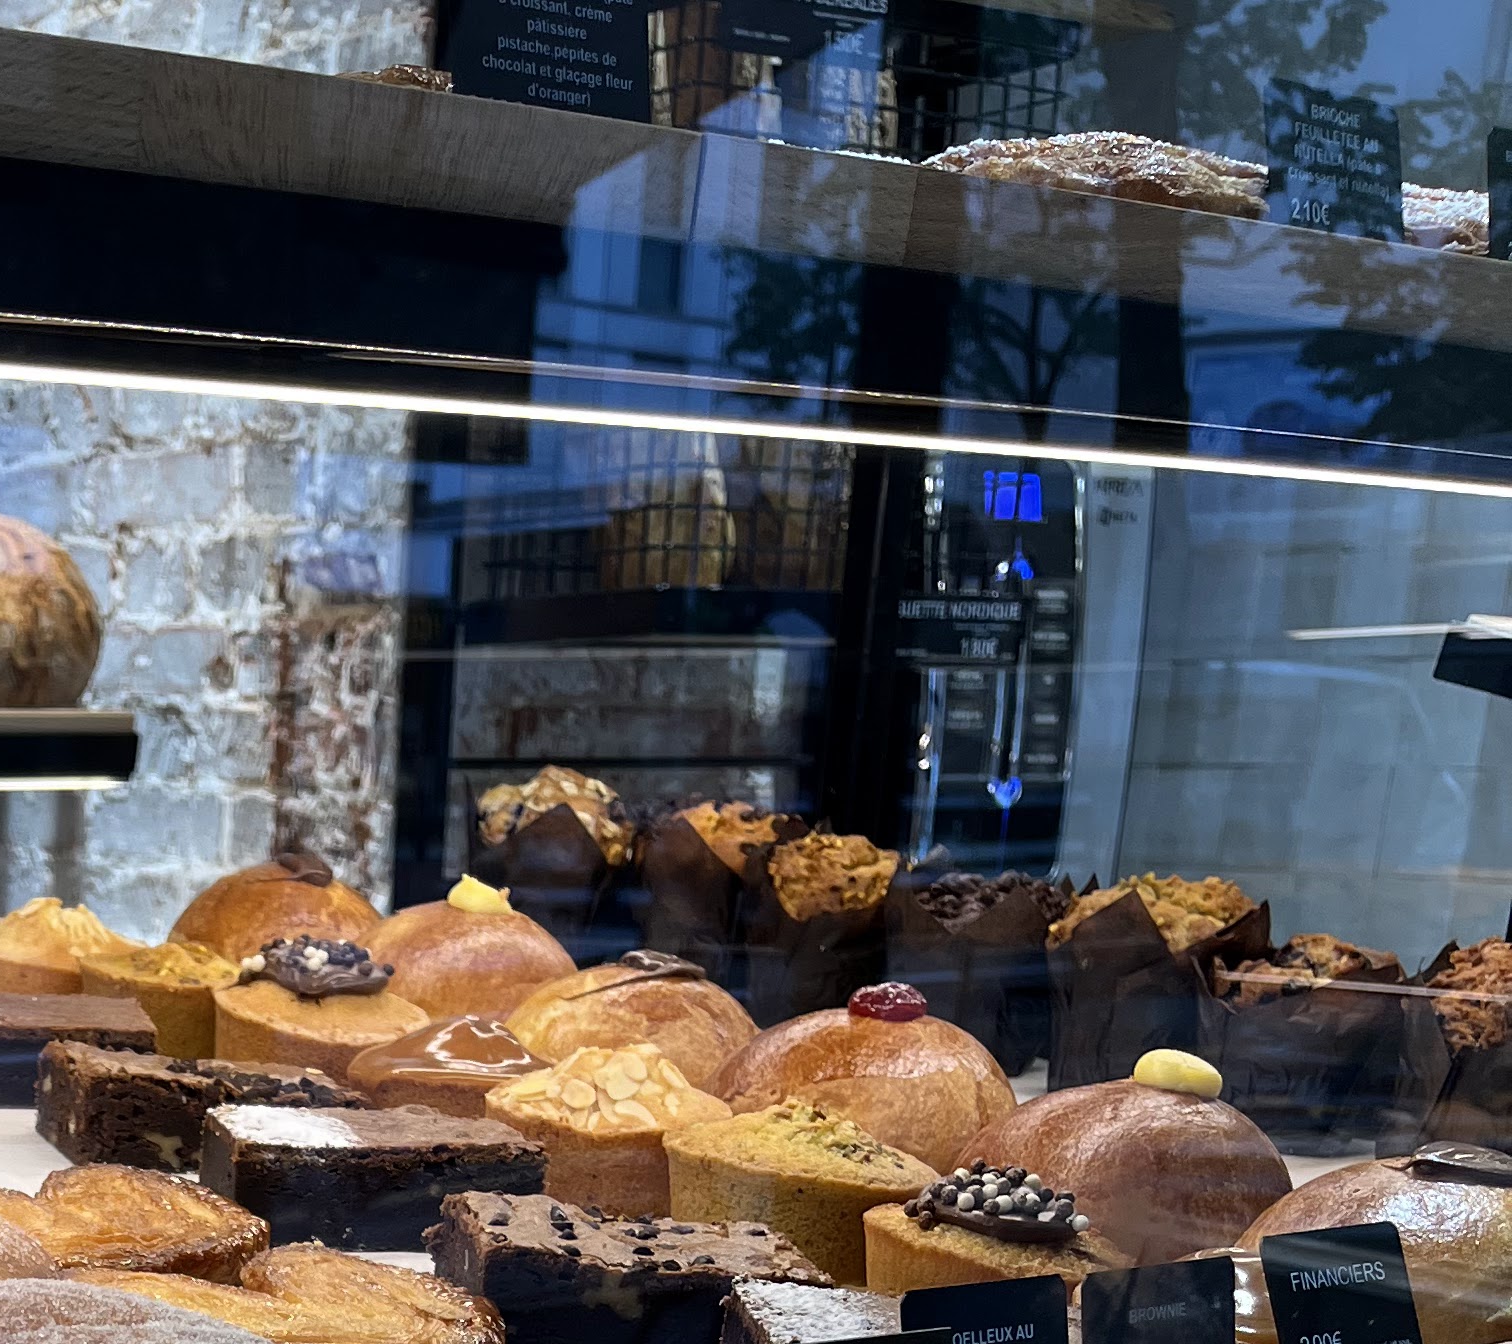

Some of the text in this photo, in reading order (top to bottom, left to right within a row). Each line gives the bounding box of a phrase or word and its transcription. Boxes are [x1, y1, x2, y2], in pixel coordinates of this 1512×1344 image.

[602, 52, 617, 67] de
[482, 54, 633, 91] chocolat et glaçage fleur
[528, 84, 591, 106] d'oranger)
[1311, 104, 1360, 128] BRIOCHE
[1290, 1261, 1386, 1292] FINANCIERS
[1128, 1302, 1187, 1325] BROWNIE
[1016, 1323, 1034, 1341] AU
